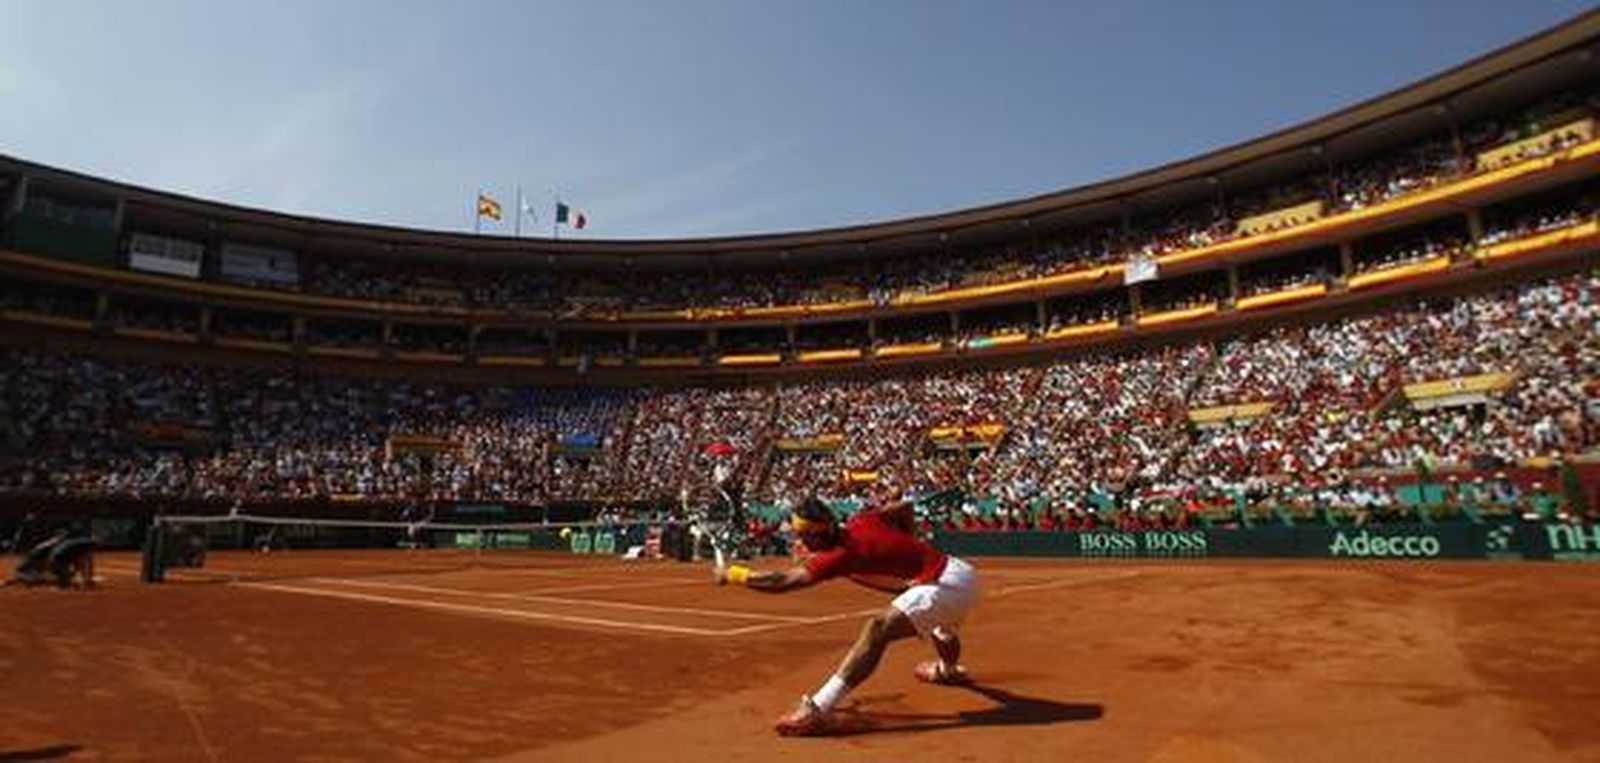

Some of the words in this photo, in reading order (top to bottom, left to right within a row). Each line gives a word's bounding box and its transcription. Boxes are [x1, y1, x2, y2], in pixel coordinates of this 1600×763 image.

[1079, 532, 1136, 550] BOSS
[1145, 531, 1207, 549] BOSS
[1329, 531, 1440, 556] Adecco
